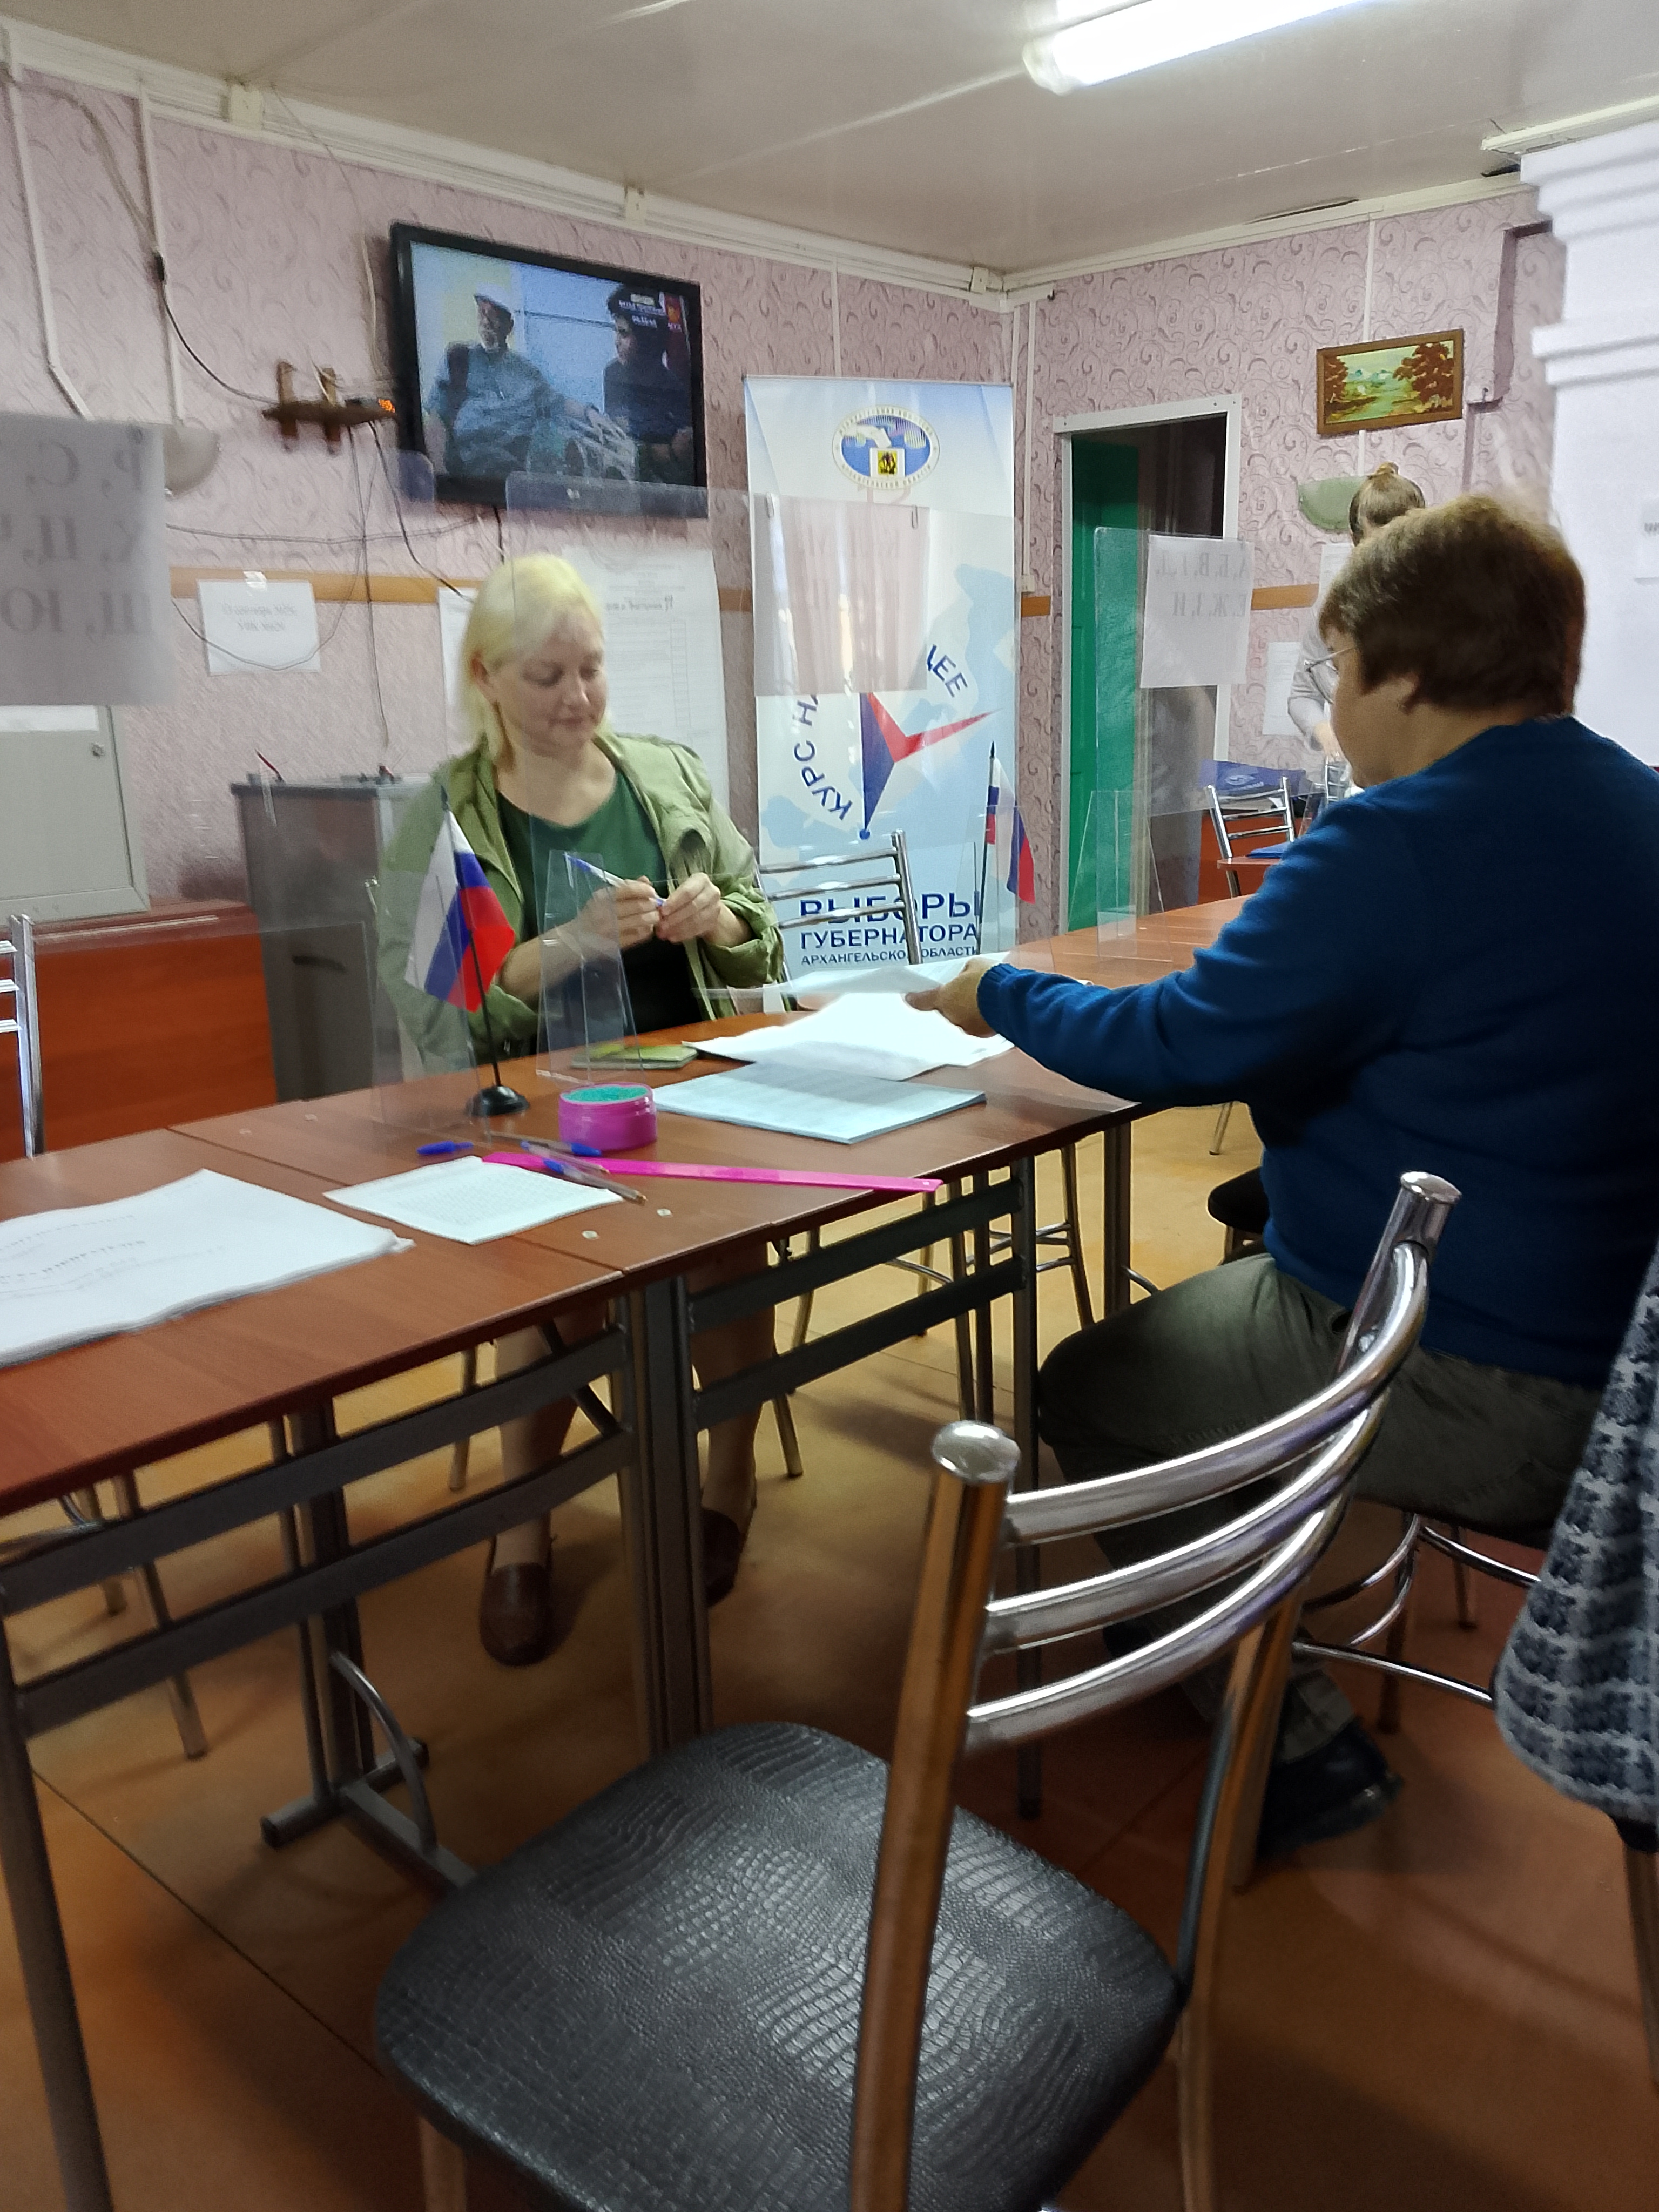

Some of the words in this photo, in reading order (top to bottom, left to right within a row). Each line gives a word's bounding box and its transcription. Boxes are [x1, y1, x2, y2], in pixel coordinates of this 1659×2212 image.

[793, 740, 853, 821] КУРС
[801, 923, 978, 949] ГУБЕРНТОРА
[801, 949, 908, 965] АРХАНГЕЛЬСКО
